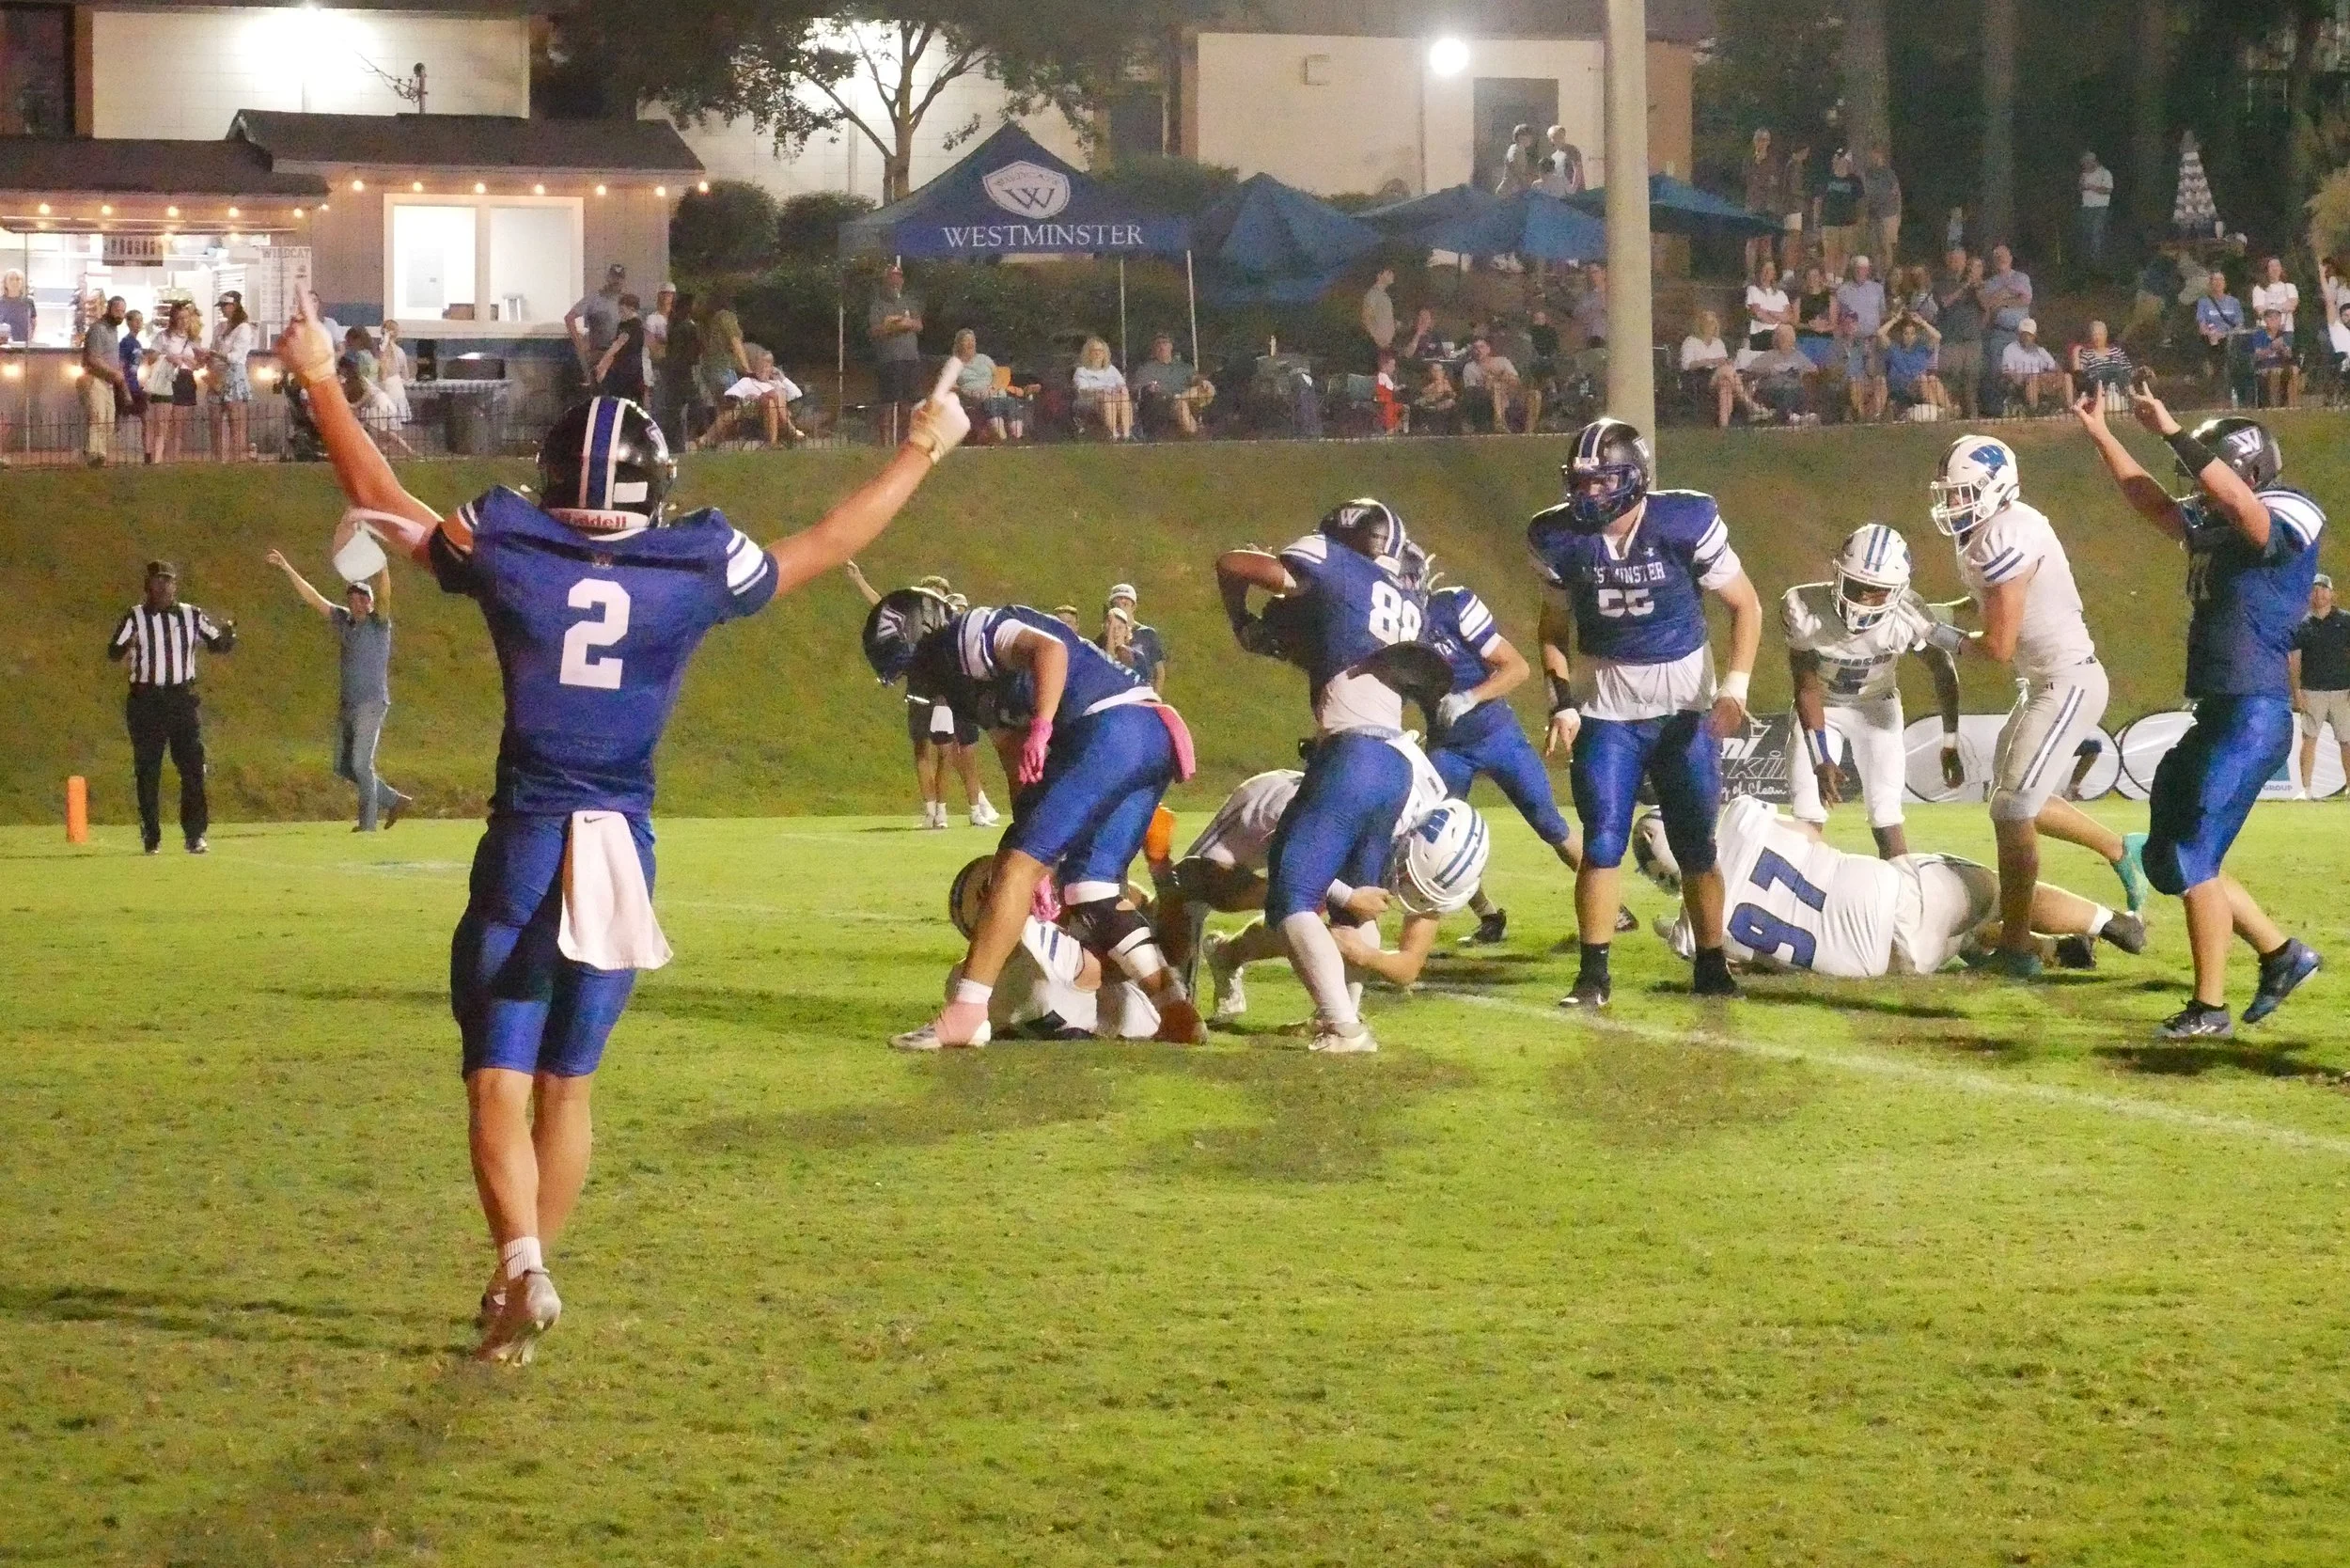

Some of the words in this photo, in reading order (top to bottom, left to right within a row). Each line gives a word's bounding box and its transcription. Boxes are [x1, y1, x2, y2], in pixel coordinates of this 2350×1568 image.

[942, 224, 1144, 247] WESTMINSTER
[1598, 588, 1654, 619] 55
[559, 578, 631, 689] 2
[1748, 779, 1787, 796] Clean
[1727, 846, 1827, 969] 97
